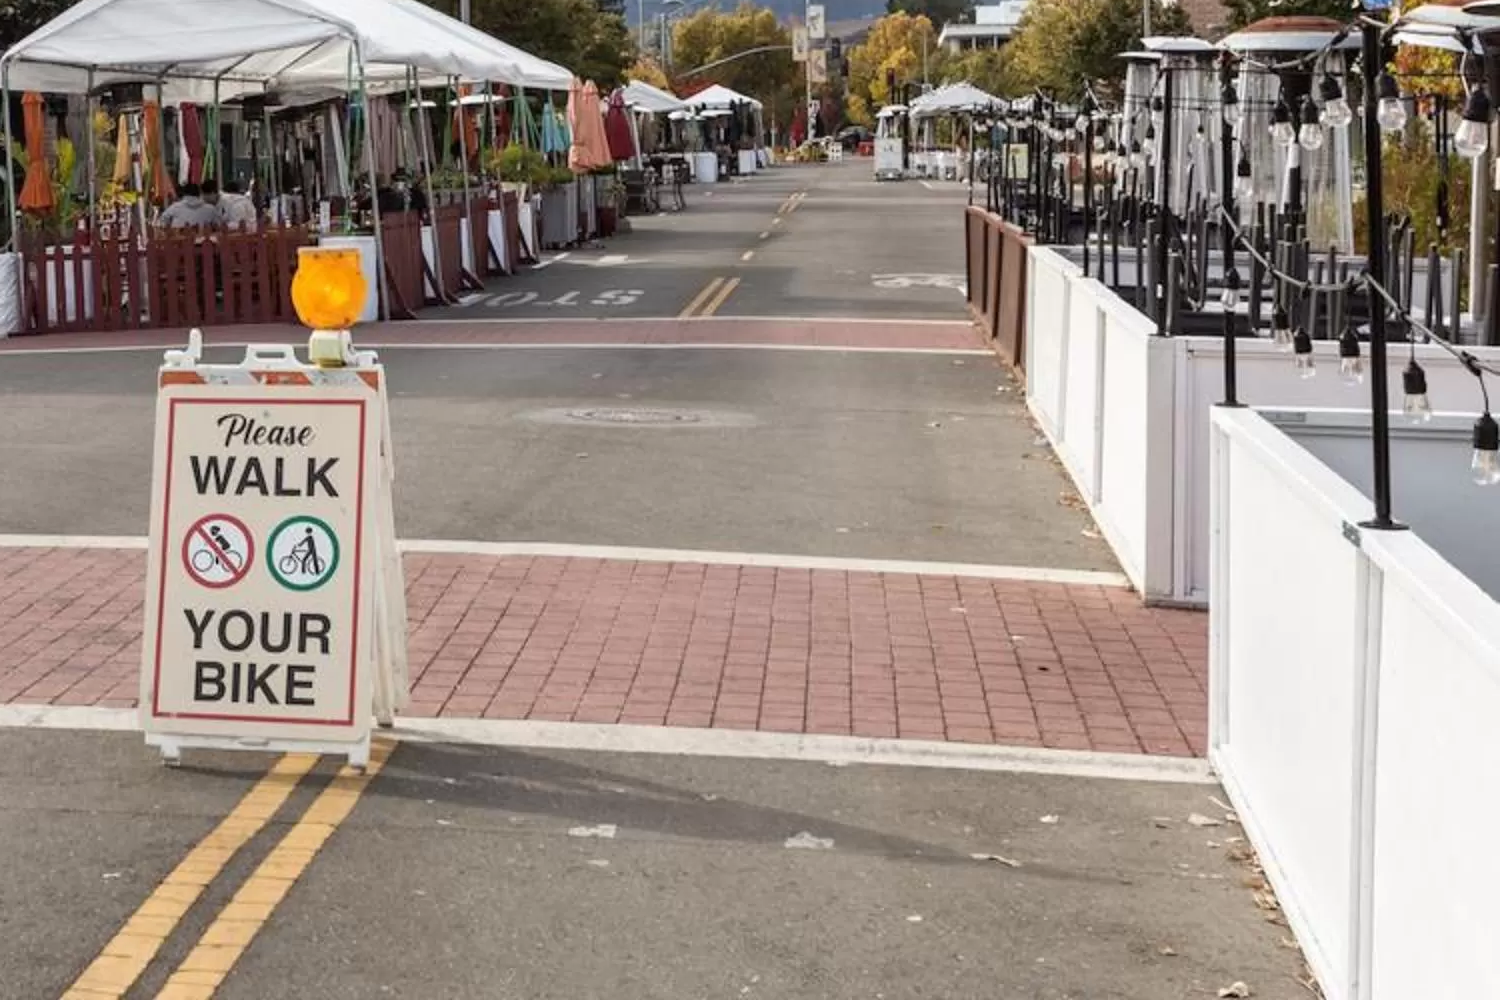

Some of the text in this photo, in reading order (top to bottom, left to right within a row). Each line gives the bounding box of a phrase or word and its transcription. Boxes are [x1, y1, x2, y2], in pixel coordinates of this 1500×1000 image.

[217, 413, 317, 447] Please
[189, 455, 340, 498] WALK
[183, 608, 331, 654] YOUR
[193, 661, 316, 706] BIKE
